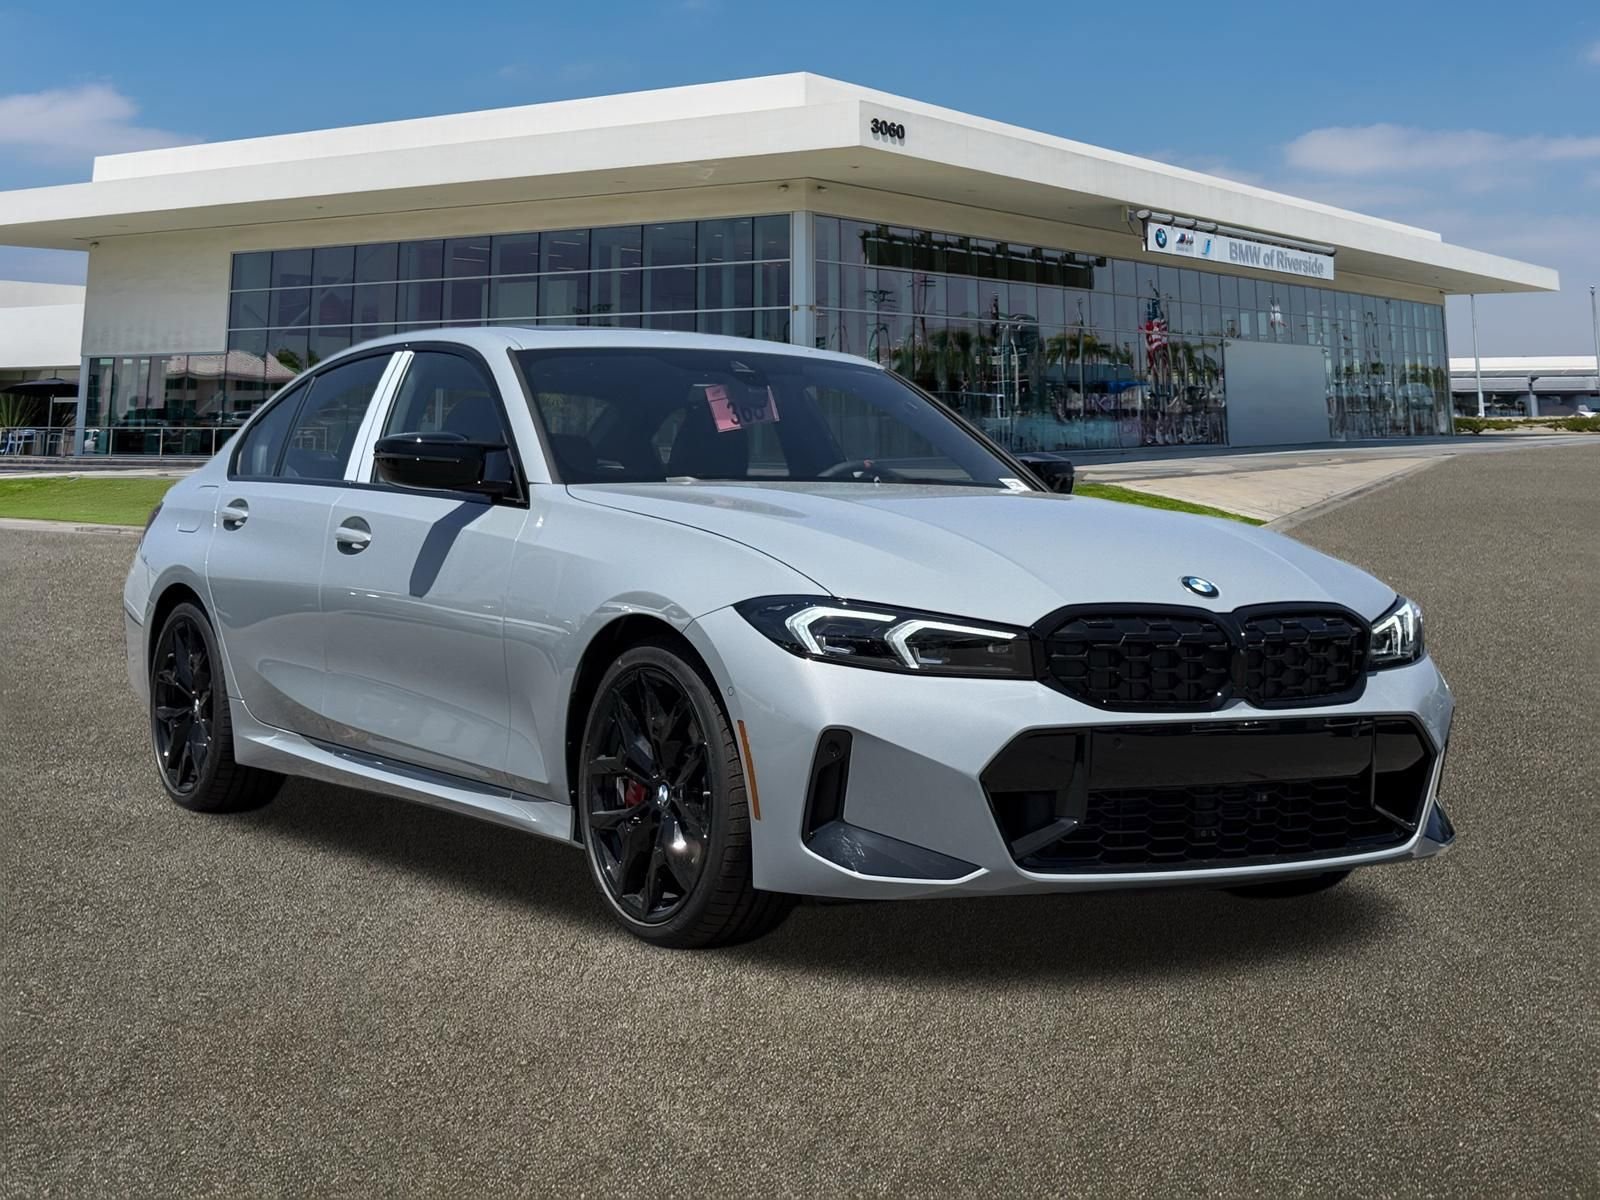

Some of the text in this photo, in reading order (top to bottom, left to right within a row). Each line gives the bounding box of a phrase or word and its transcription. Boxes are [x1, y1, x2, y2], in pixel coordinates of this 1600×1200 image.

[871, 118, 905, 140] 3060
[1229, 242, 1325, 275] BMW of Riverside
